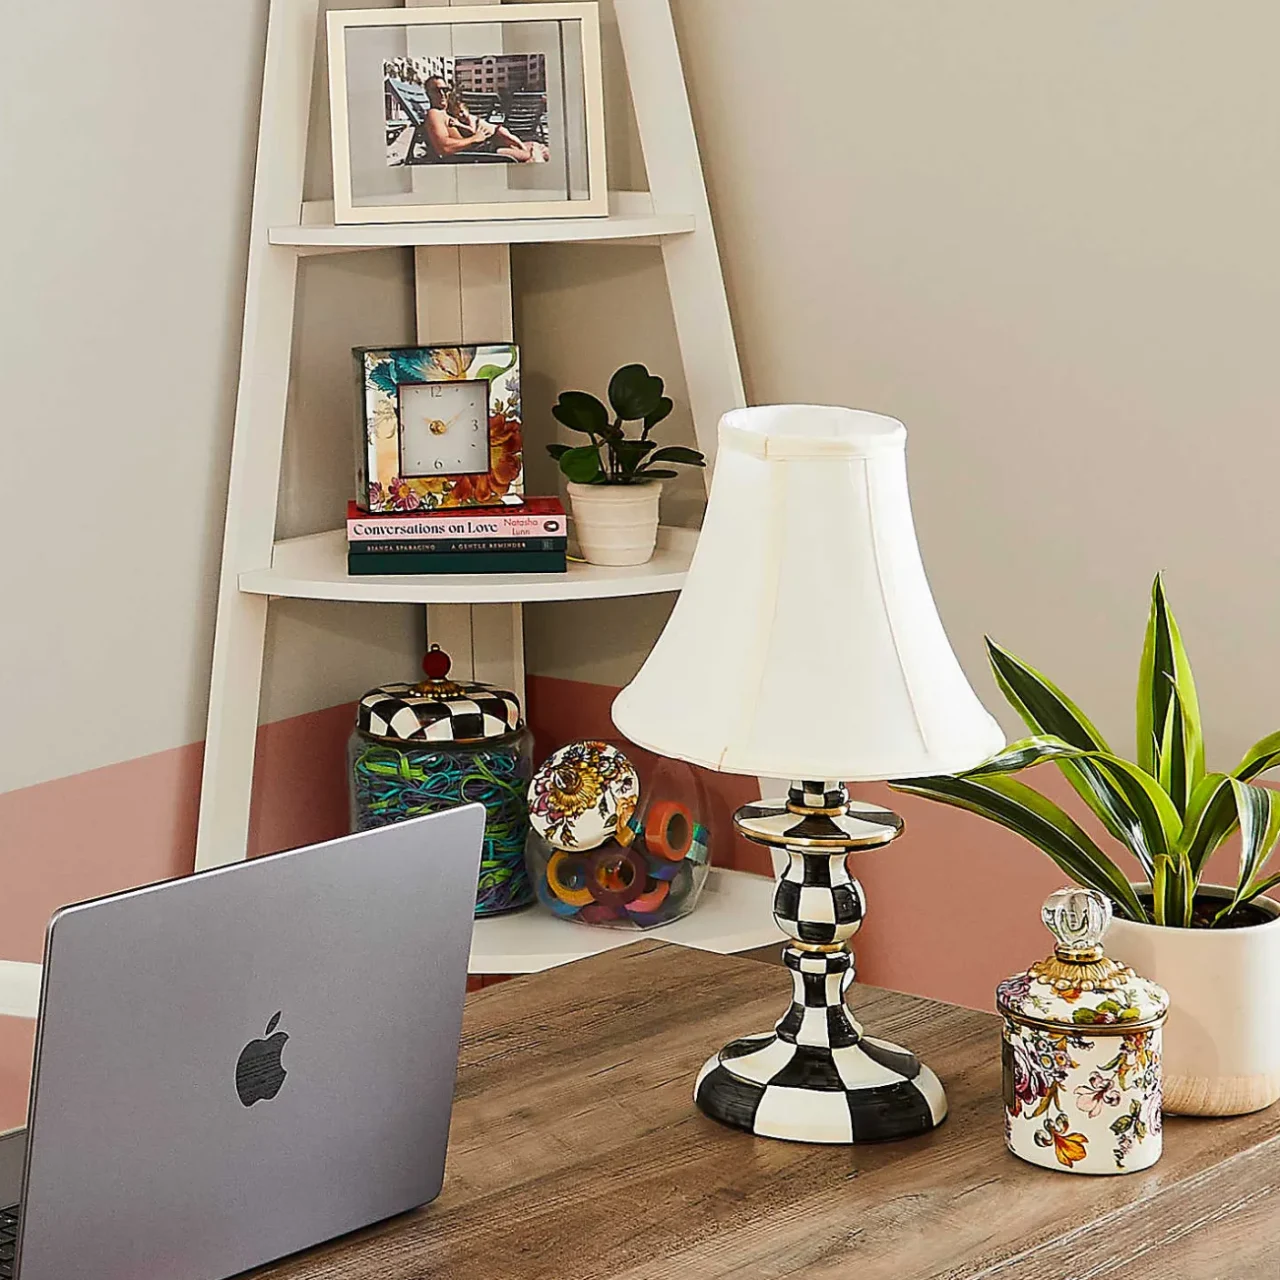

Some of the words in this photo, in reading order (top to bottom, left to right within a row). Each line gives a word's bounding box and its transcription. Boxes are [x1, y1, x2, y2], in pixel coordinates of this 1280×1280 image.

[430, 386, 442, 398] 12
[471, 419, 479, 432] 3
[434, 457, 443, 470] 6
[353, 523, 446, 536] Conversations
[448, 524, 465, 534] on
[467, 521, 498, 534] Love
[503, 517, 539, 527] Natasha
